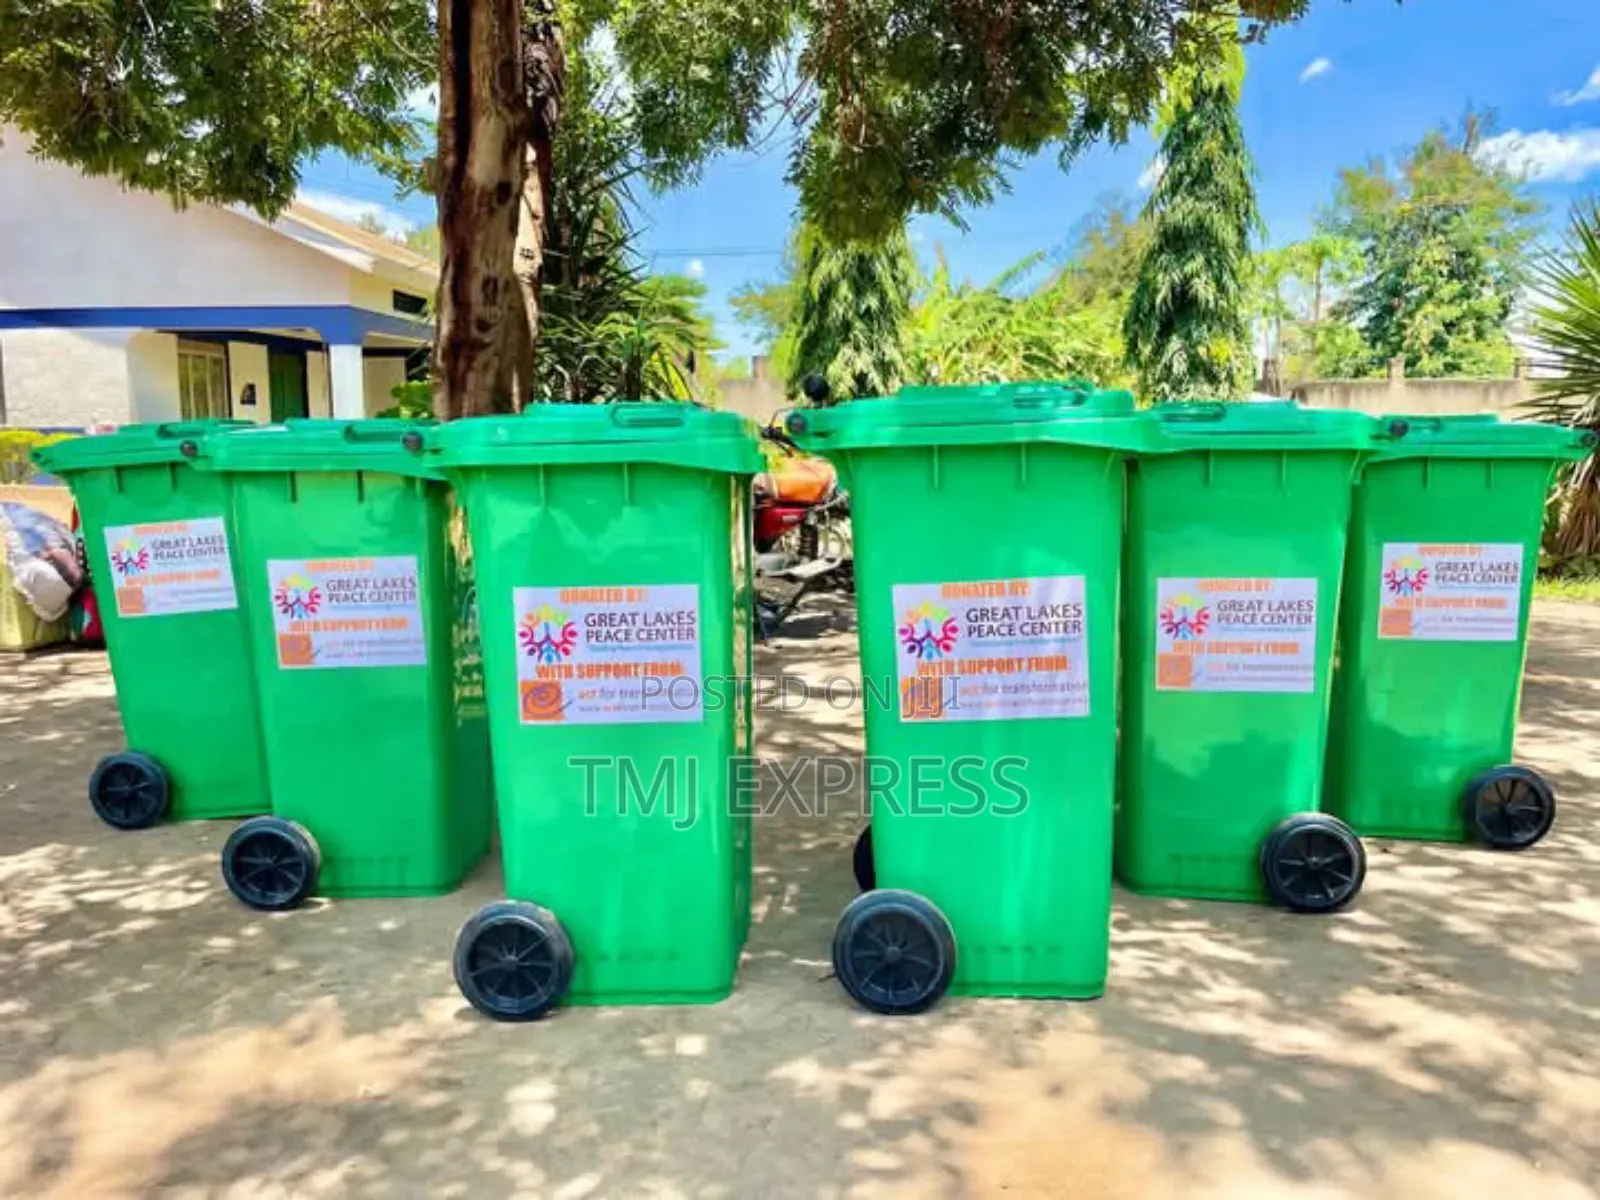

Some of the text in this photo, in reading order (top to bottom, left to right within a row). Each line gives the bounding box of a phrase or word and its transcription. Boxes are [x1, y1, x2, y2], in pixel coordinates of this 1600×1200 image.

[1435, 561, 1518, 572] GREAT LAKES
[326, 575, 416, 591] GREAT LAKES
[1435, 573, 1518, 583] PEACE CENTER
[327, 590, 416, 603] PEACE CENTER
[942, 581, 1005, 598] DONATED
[966, 603, 1082, 623] GREAT LAKES
[1217, 600, 1314, 612] GREAT LAKES
[584, 610, 696, 628] GREAT LAKES
[1217, 613, 1313, 625] PEACE CENTER
[586, 628, 696, 643] PEACE CENTER
[967, 620, 1082, 638] PEACE CENTER
[536, 662, 685, 679] WITH SUPPORT FROM
[917, 655, 1068, 676] WITH SUPPORT FROM
